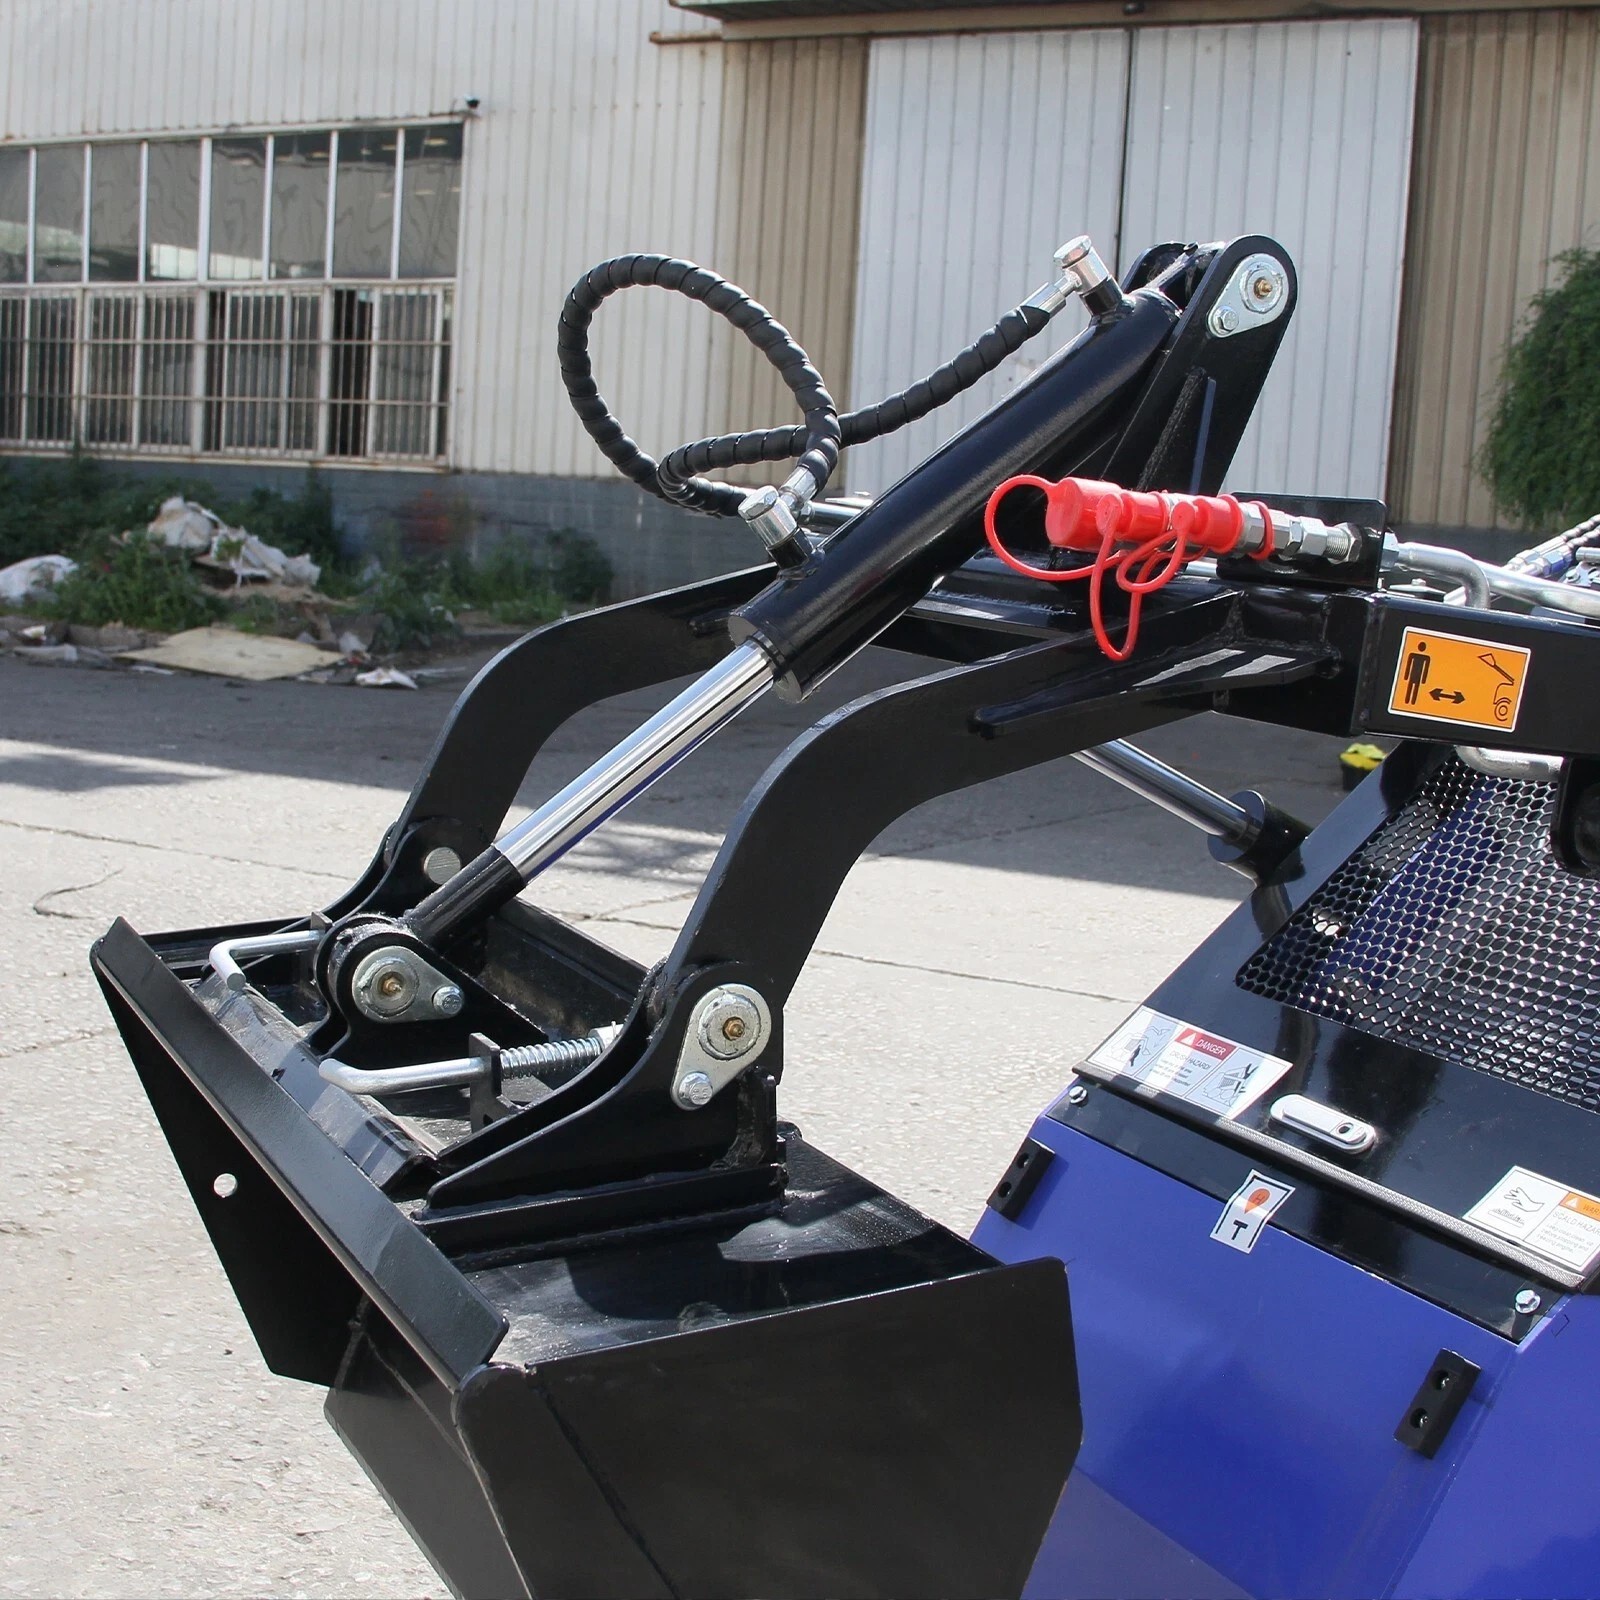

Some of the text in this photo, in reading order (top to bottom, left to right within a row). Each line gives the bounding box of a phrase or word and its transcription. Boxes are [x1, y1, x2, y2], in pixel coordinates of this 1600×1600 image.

[1196, 1039, 1227, 1056] DANGER
[1583, 1204, 1600, 1216] WAR
[1553, 1211, 1578, 1225] SCALD
[1232, 1219, 1248, 1240] T
